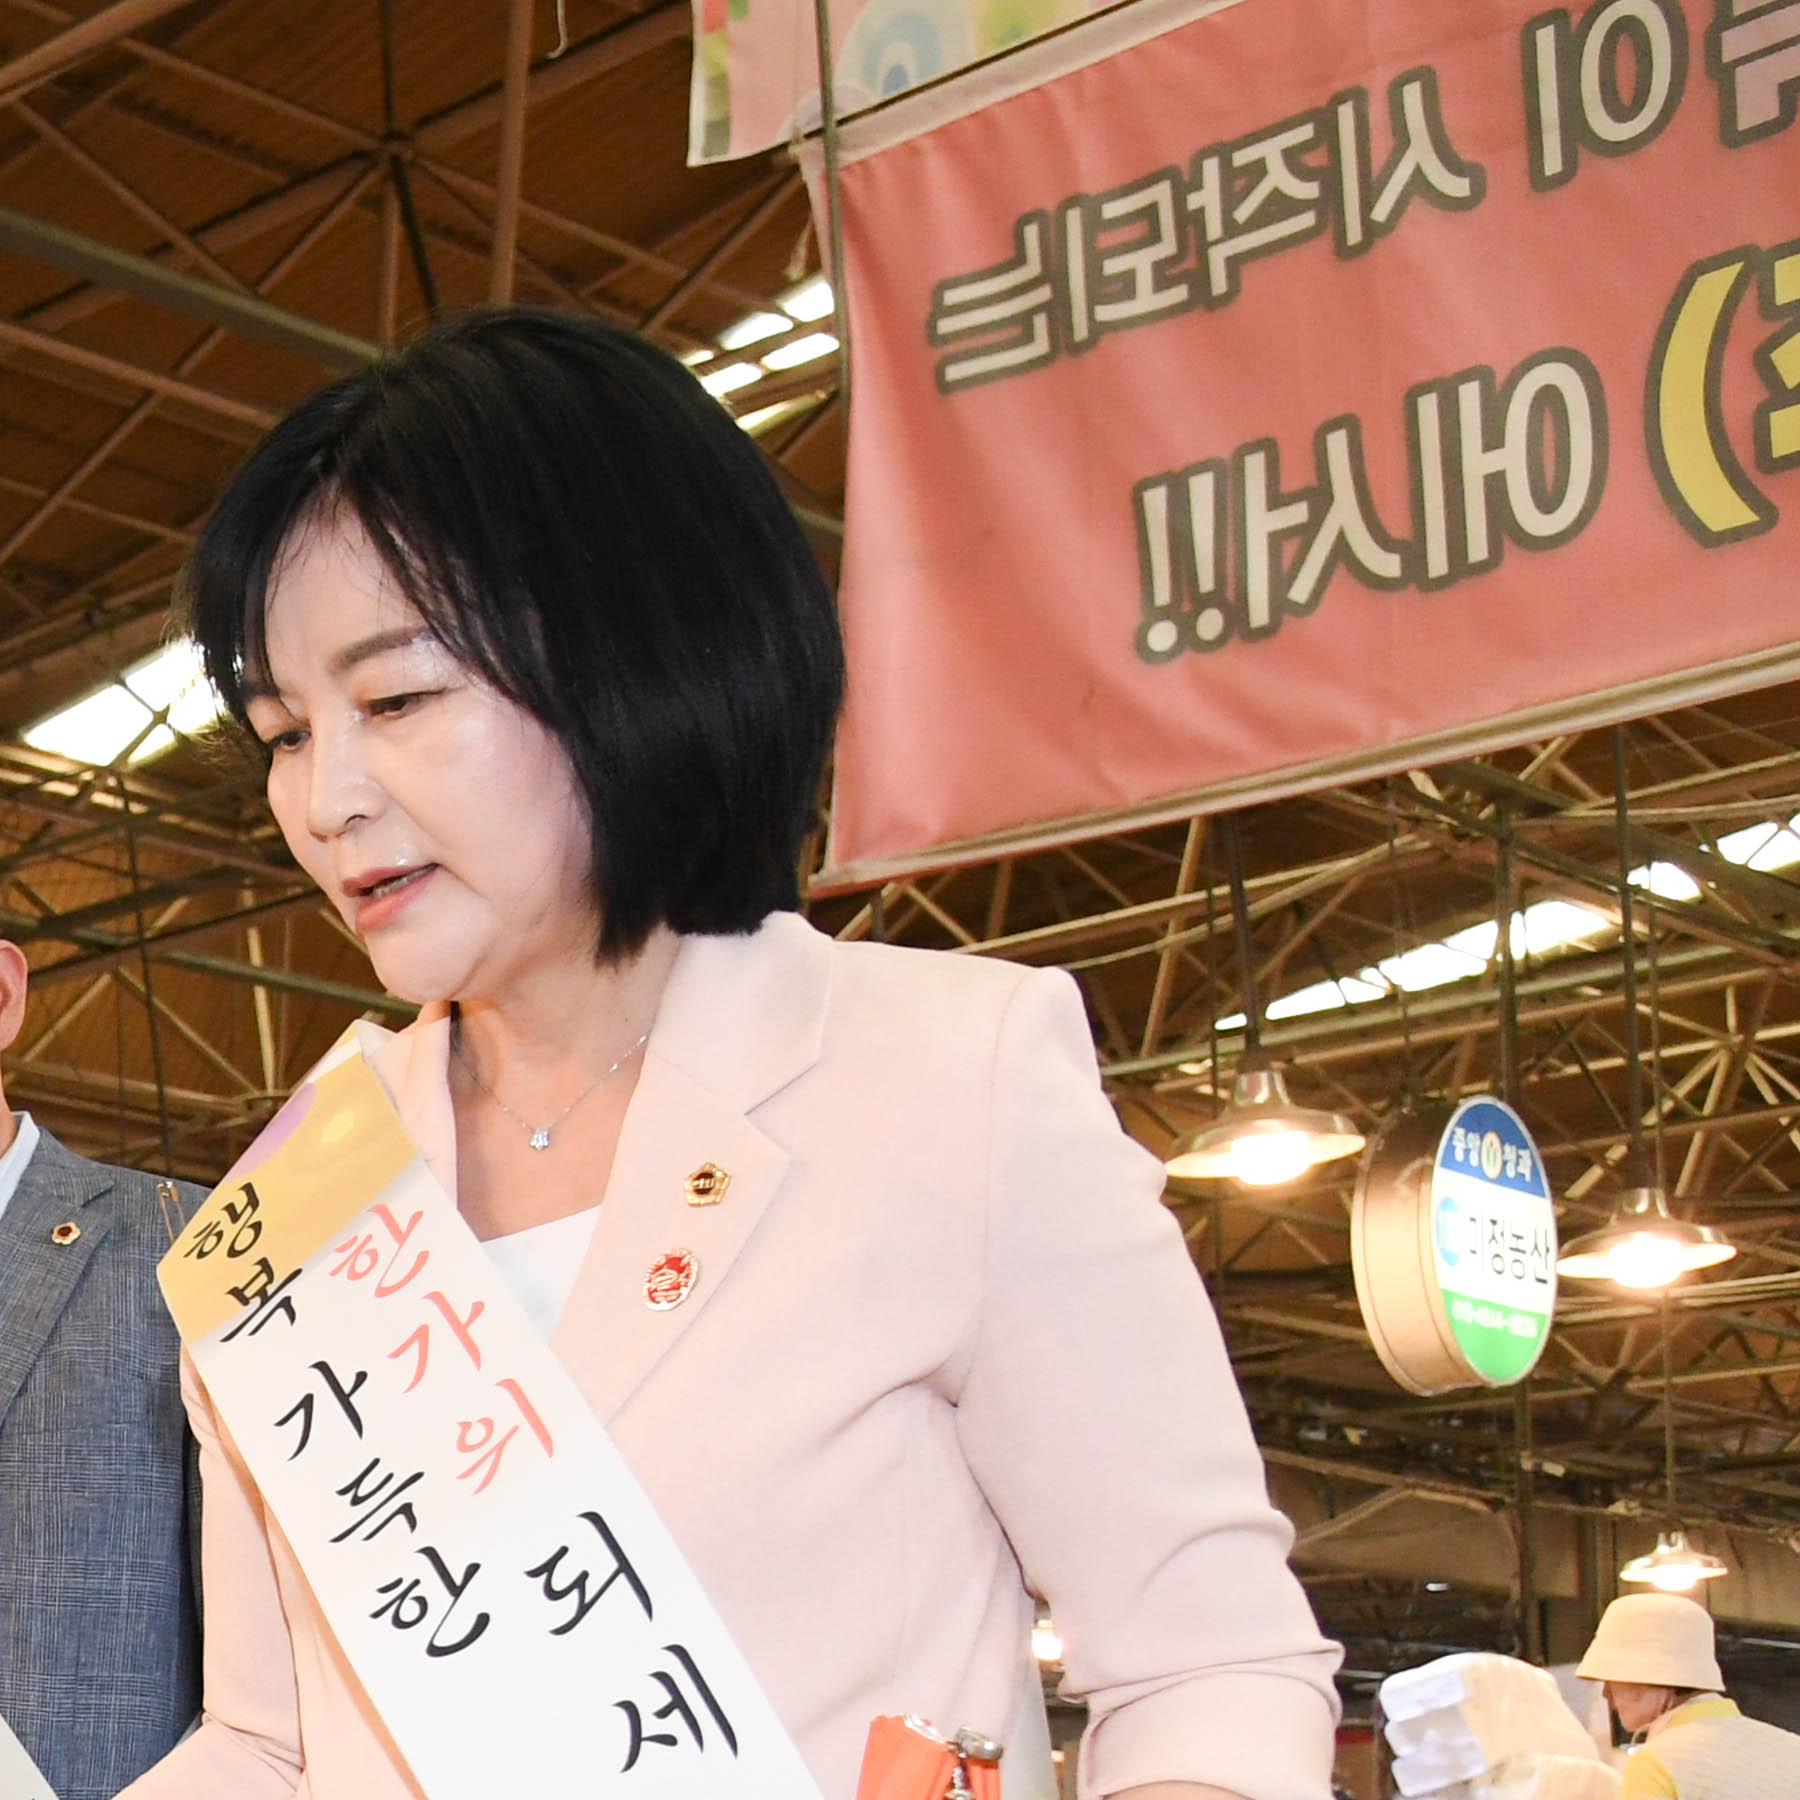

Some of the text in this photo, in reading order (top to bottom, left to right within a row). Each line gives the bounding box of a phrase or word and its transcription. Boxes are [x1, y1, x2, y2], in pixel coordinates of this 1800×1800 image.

[1452, 1127, 1533, 1184] 중앙 청과
[183, 1183, 491, 1658] 행복 가득한
[329, 1203, 555, 1496] 한가위
